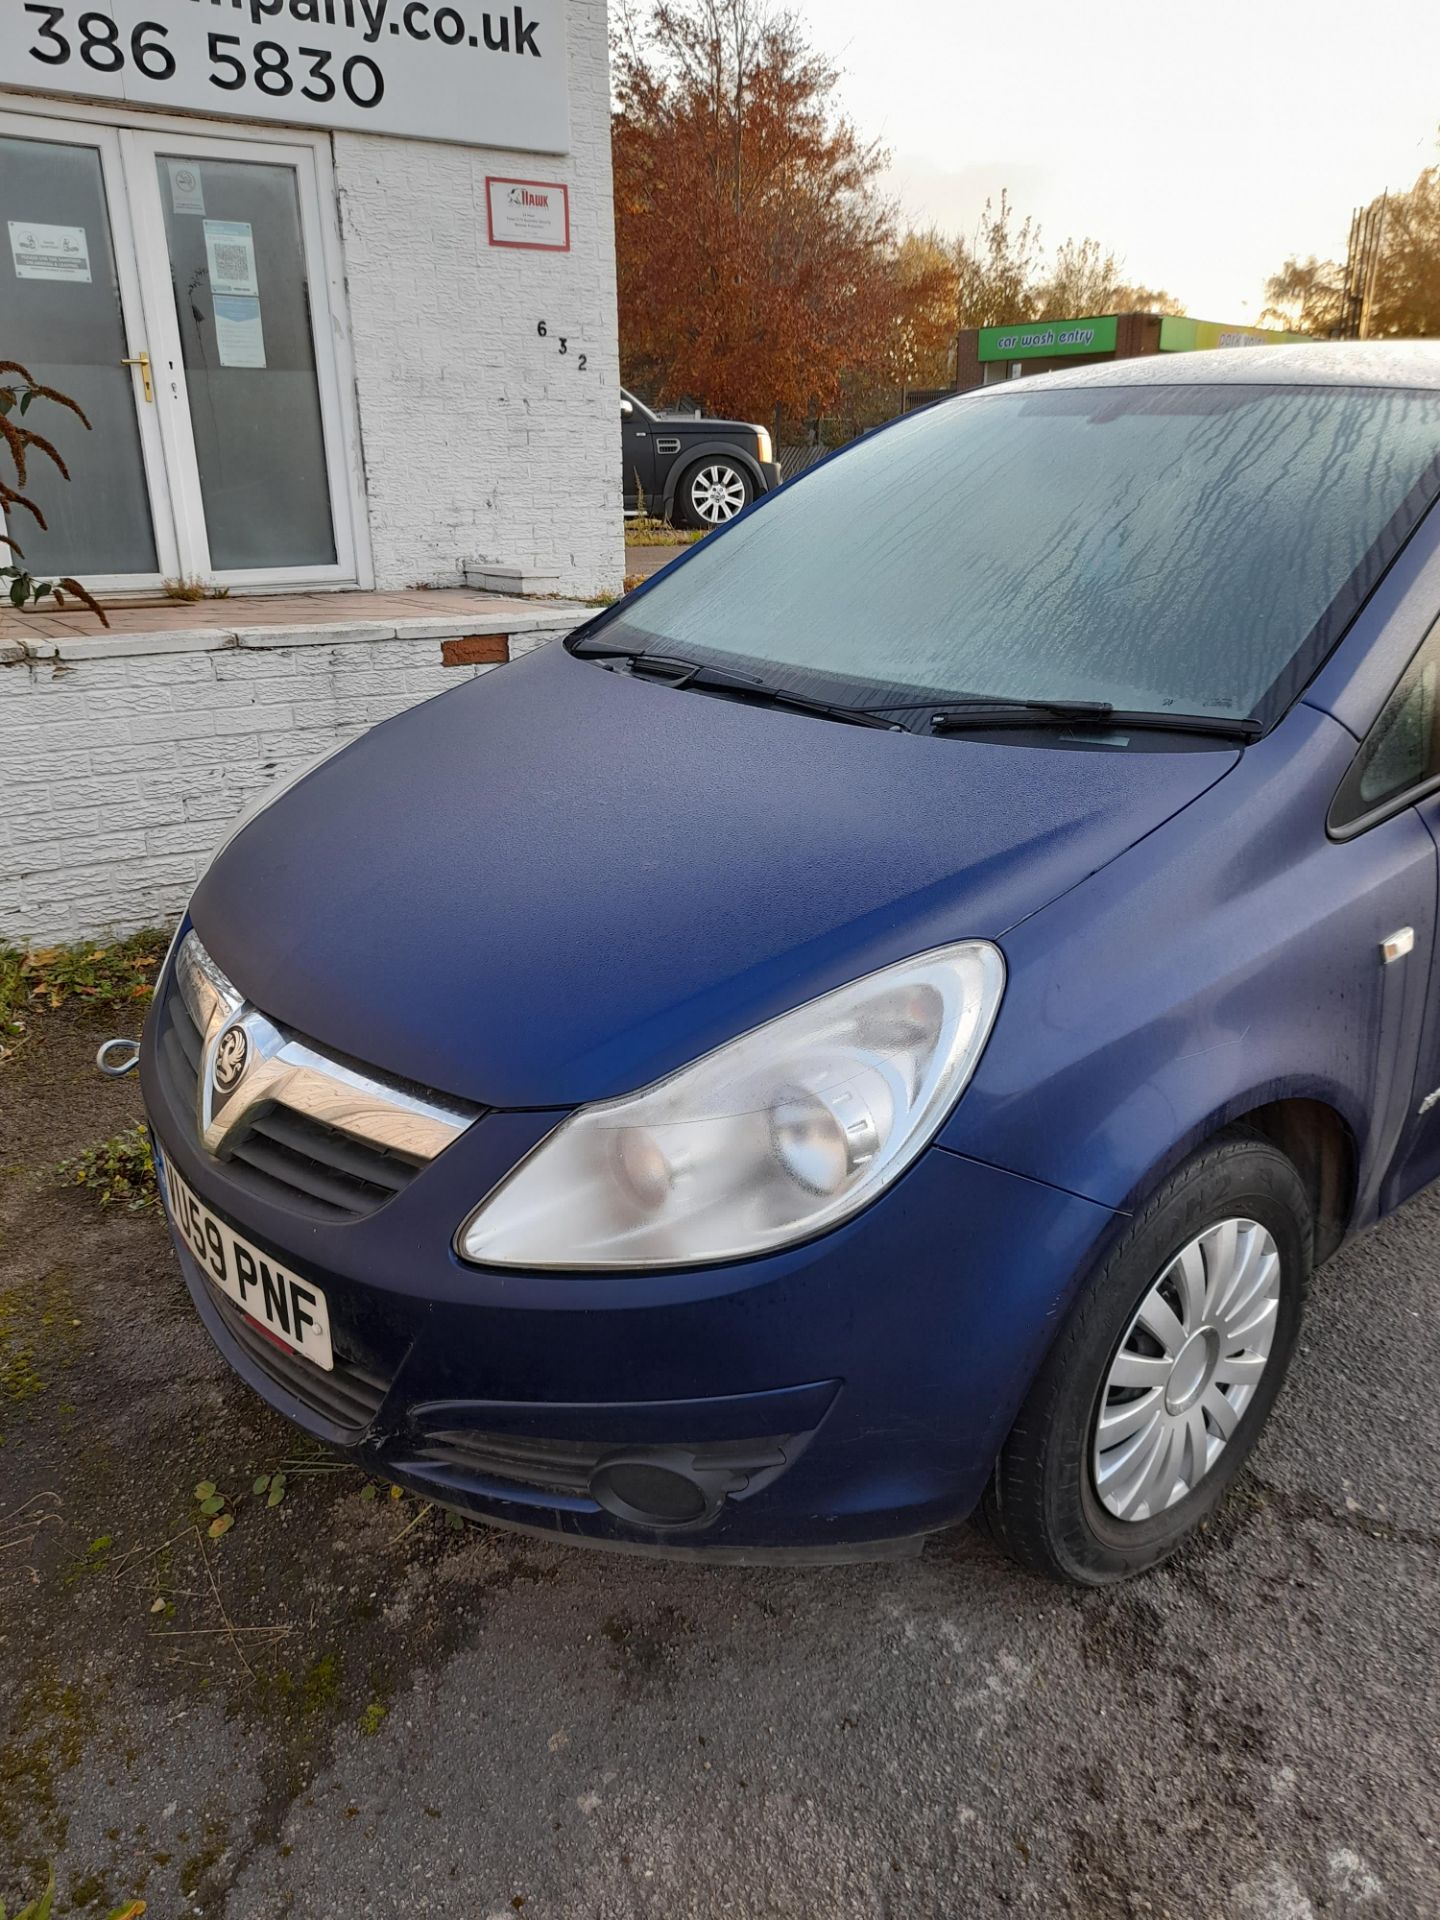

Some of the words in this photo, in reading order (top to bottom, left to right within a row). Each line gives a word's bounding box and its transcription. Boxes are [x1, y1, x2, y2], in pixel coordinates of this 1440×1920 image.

[24, 3, 176, 80] 386
[207, 32, 385, 109] 5830
[190, 0, 542, 58] pany.co.uk
[537, 320, 547, 337] 6
[558, 337, 567, 355] 3
[578, 354, 587, 371] 2
[998, 337, 1017, 349] car
[1021, 331, 1054, 347] wash
[1059, 329, 1094, 346] entry
[233, 1241, 317, 1343] PNF
